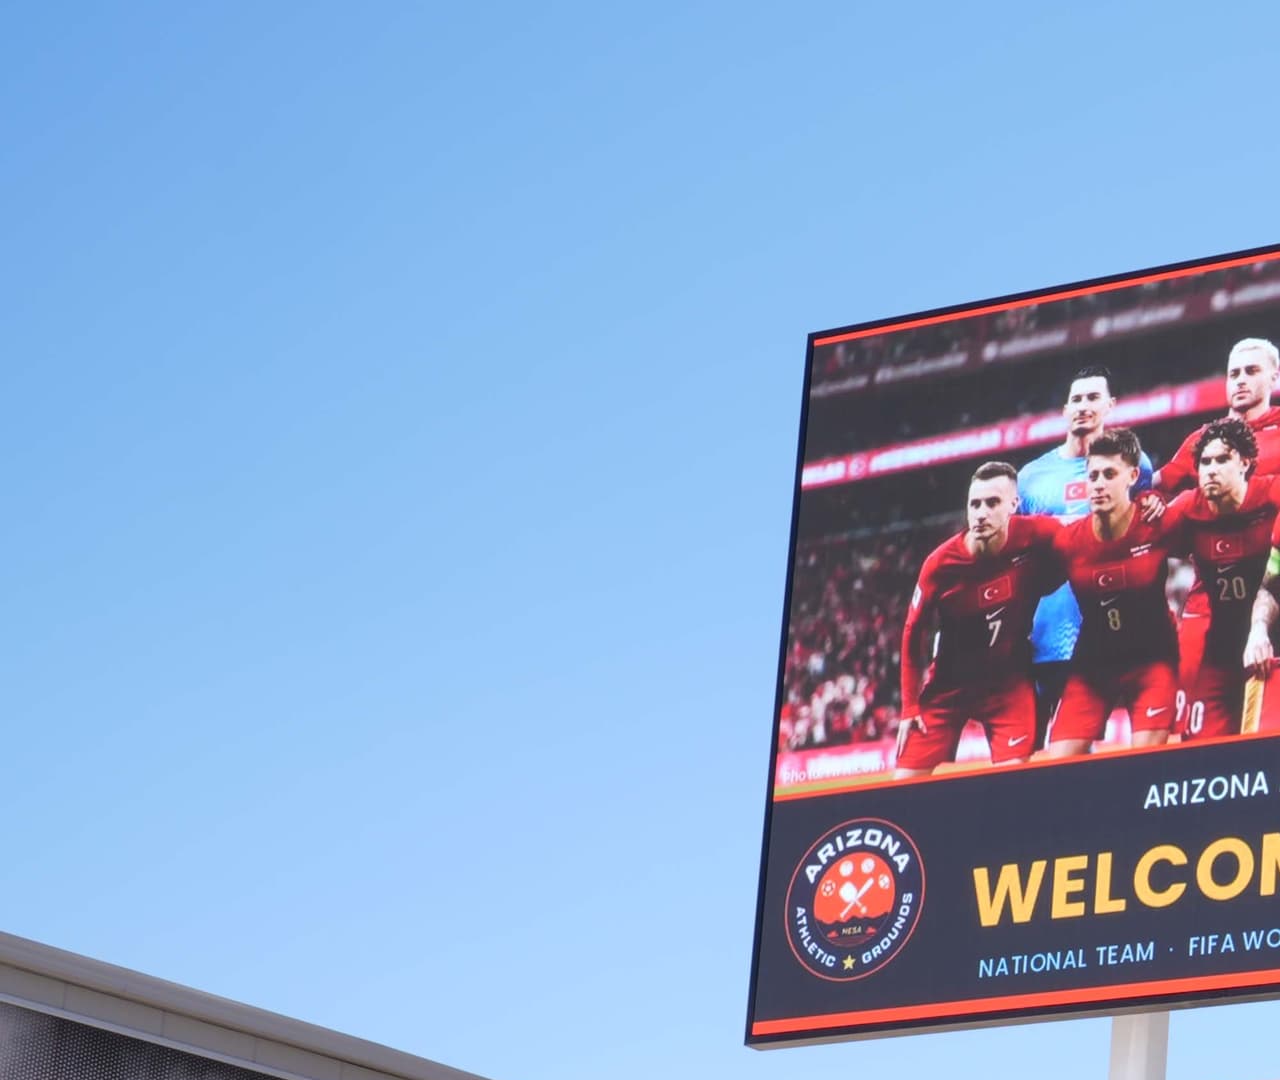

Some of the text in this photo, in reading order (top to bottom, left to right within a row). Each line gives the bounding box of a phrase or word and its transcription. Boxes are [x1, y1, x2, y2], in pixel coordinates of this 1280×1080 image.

[1216, 576, 1246, 600] 20
[988, 619, 1003, 647] 7
[1107, 609, 1121, 631] 8
[1144, 772, 1270, 809] ARIZONA
[805, 828, 911, 884] ARIZONA
[796, 892, 913, 967] ATHLETIC GROUNDS
[978, 948, 1087, 979] NATIONAL
[1096, 941, 1156, 968] TEAM
[1188, 933, 1236, 957] FIFA
